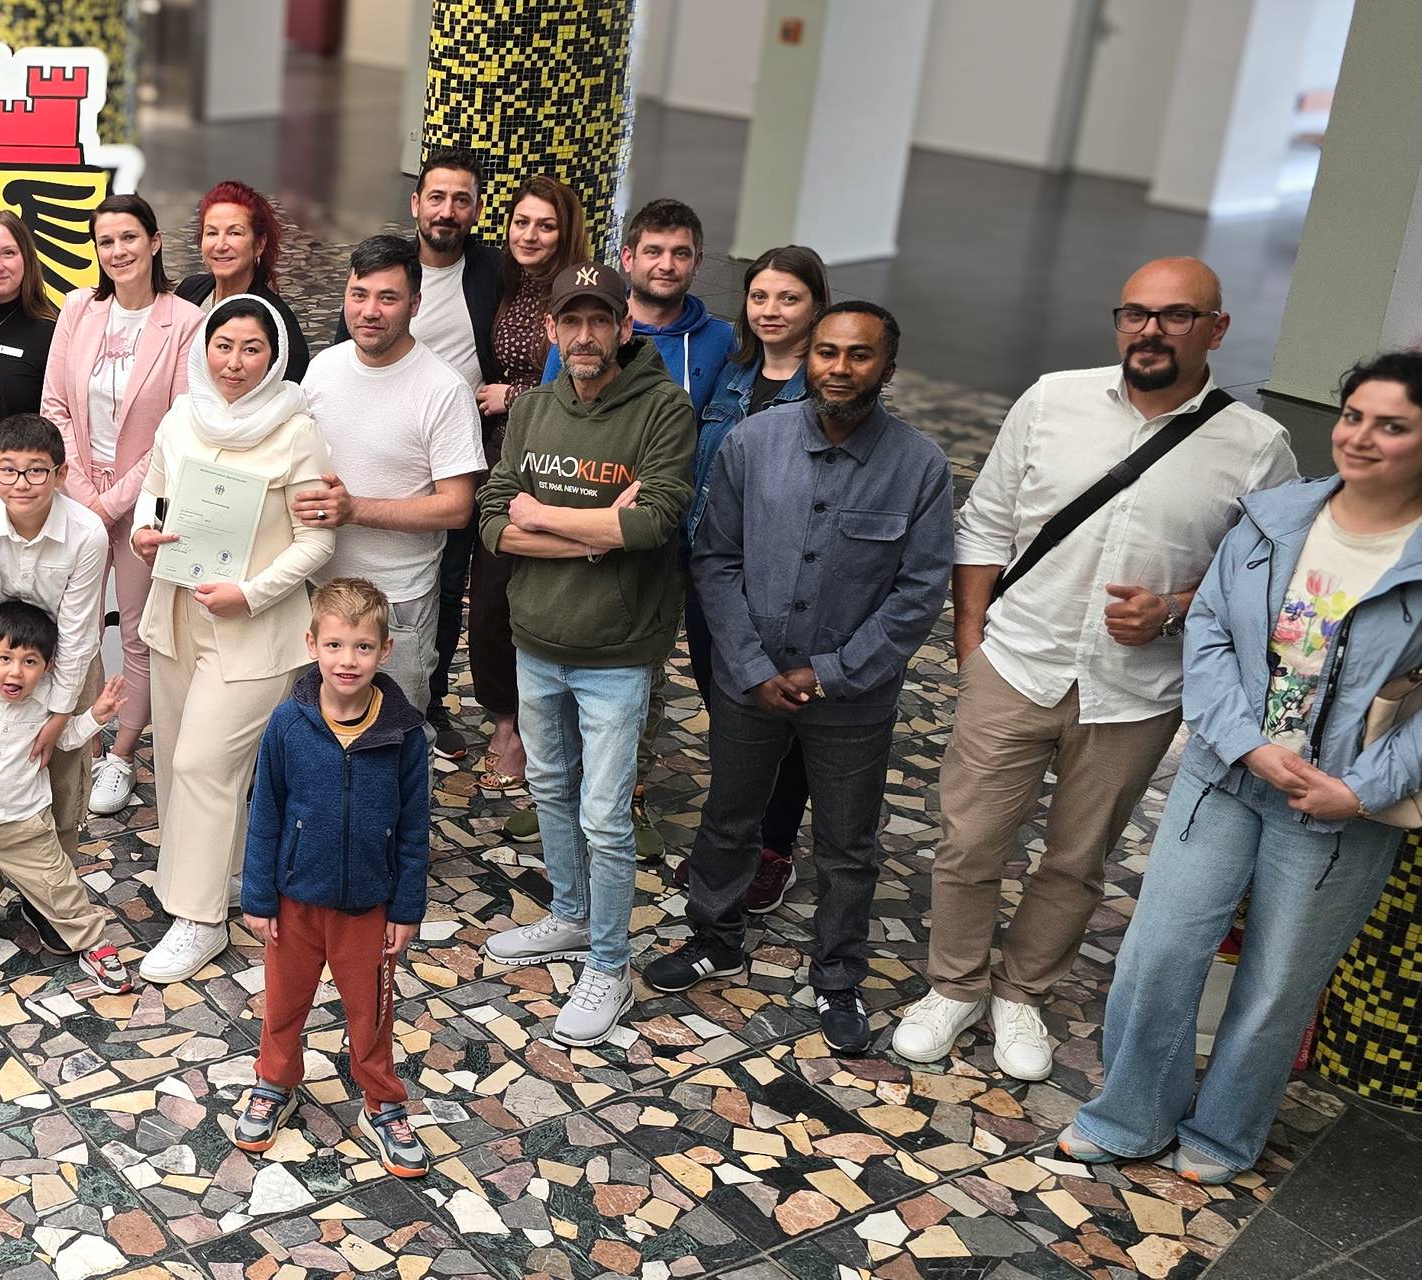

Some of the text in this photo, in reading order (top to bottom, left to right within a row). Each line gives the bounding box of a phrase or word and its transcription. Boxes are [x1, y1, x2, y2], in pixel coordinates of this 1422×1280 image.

[575, 266, 599, 286] NY
[577, 458, 635, 484] KLEIN
[564, 484, 579, 494] NEW
[580, 487, 598, 497] YORK
